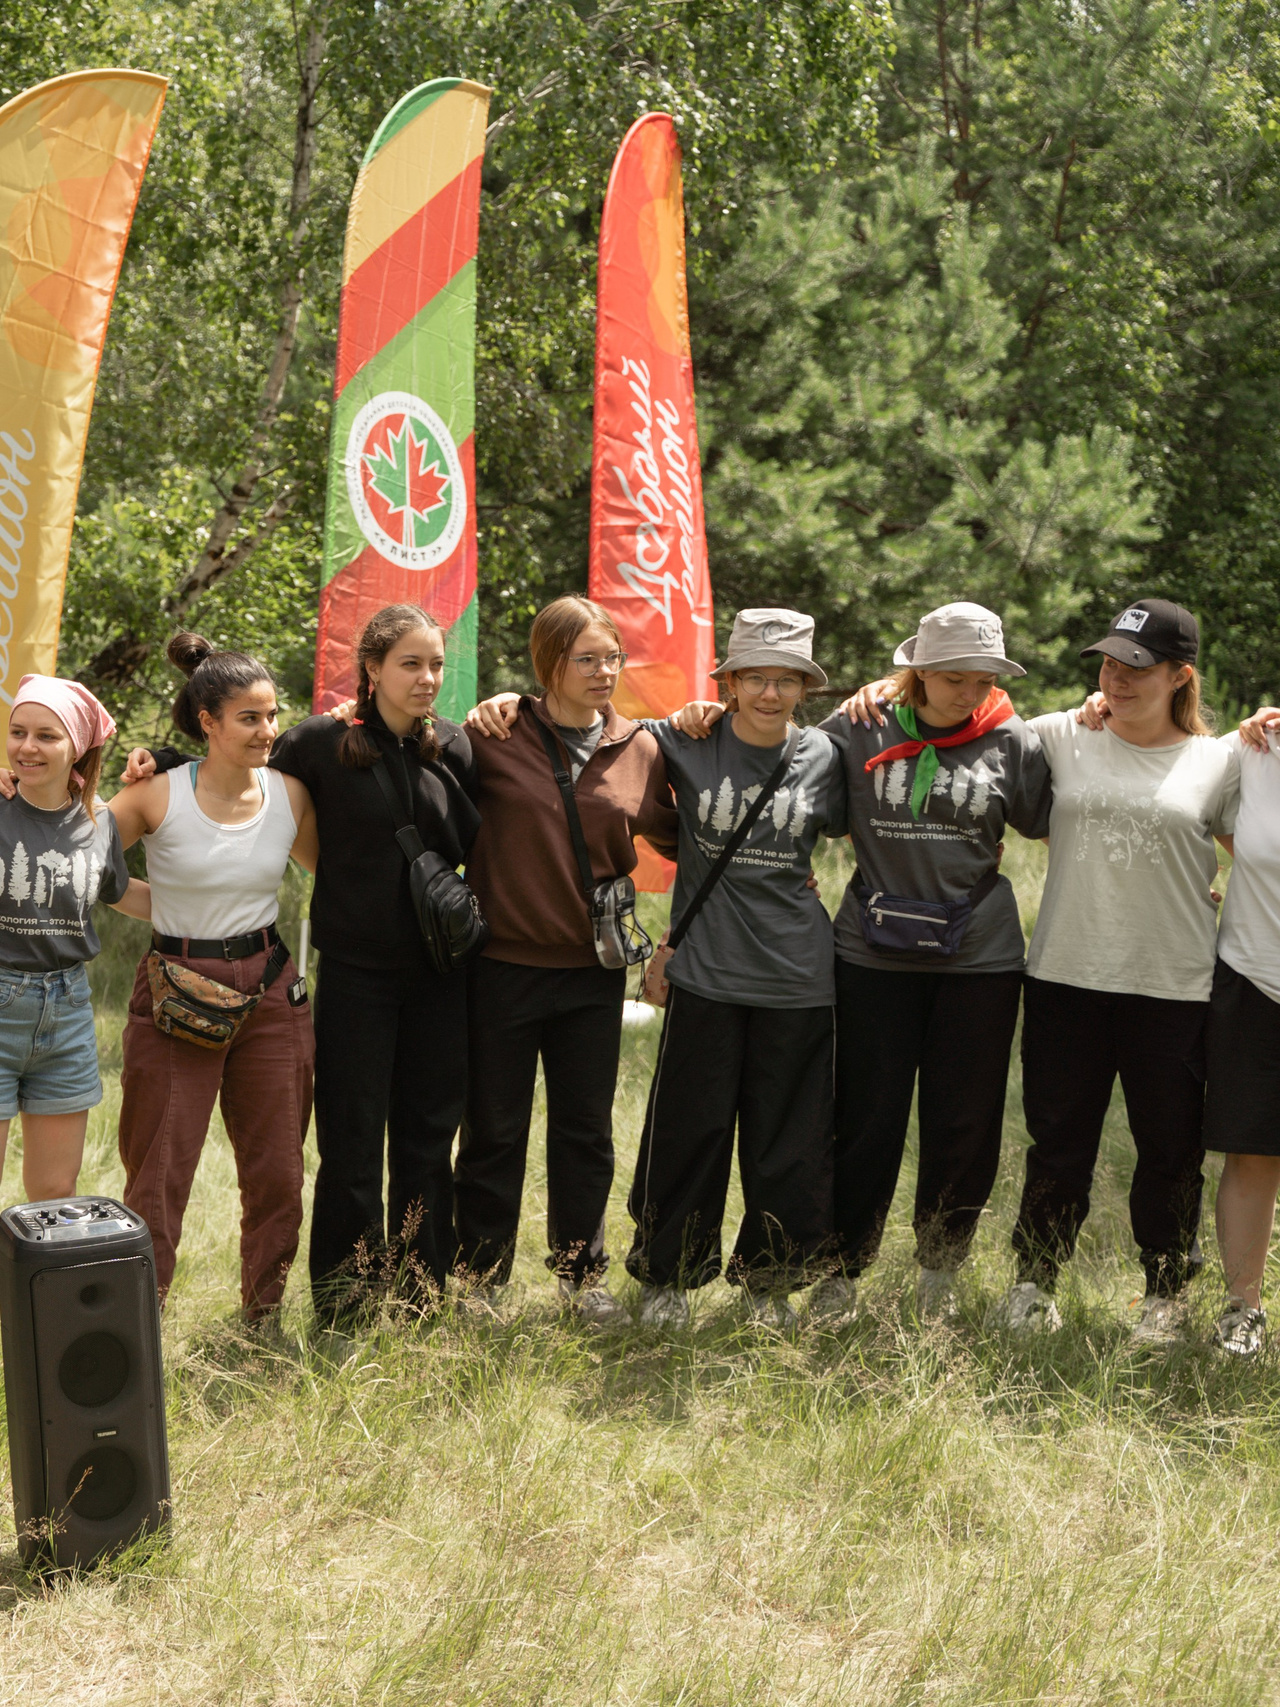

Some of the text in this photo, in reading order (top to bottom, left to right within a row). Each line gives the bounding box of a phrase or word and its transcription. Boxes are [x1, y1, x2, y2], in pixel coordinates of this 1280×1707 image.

[612, 355, 681, 635] Добрый
[876, 828, 893, 838] Это
[743, 848, 762, 856] это
[764, 850, 777, 858] не
